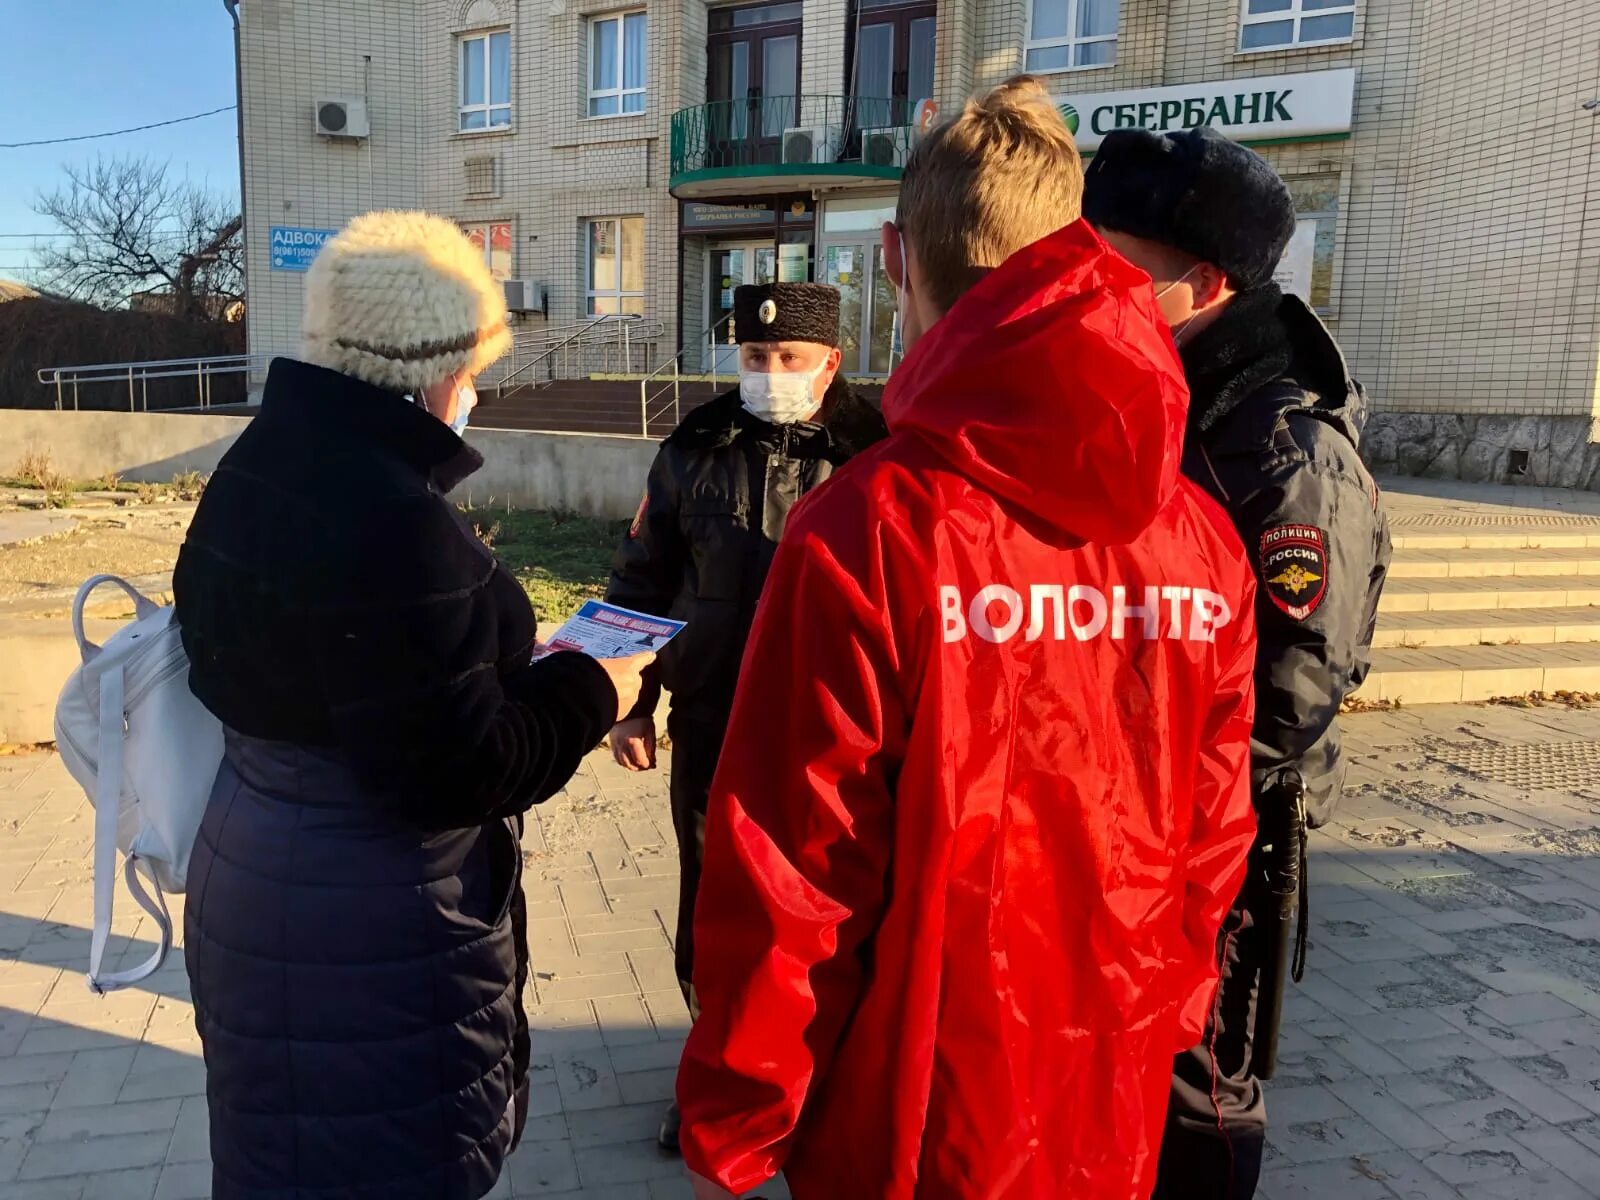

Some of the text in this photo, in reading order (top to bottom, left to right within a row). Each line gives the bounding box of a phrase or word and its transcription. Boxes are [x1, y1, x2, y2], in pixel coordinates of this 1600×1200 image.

[1091, 89, 1293, 136] СБЕРБАНК
[1266, 528, 1318, 544] ПОЛИЦИЯ
[1269, 548, 1319, 565] РОССИЯ
[1287, 604, 1310, 620] МВД
